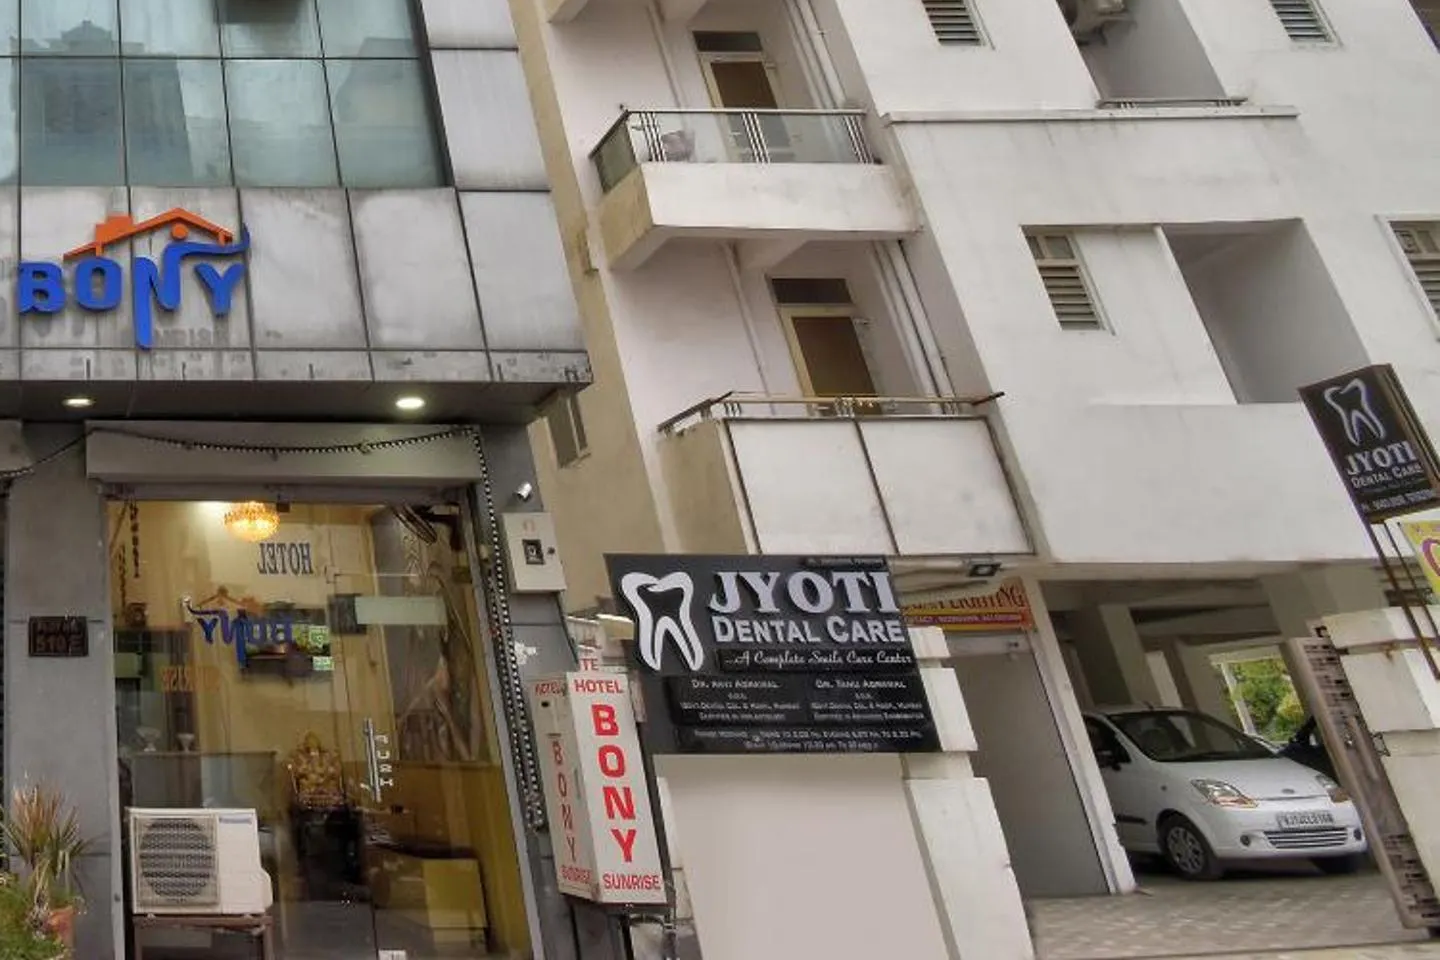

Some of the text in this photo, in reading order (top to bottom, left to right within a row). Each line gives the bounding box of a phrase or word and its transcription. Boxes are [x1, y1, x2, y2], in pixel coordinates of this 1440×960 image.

[18, 223, 251, 351] BONY
[1345, 441, 1417, 476] JYOTI
[709, 570, 901, 614] JYOTI
[711, 615, 906, 644] DENTAL CARE
[754, 650, 806, 668] Complete
[574, 679, 624, 695] HOTEL
[591, 703, 637, 864] BONY
[550, 741, 577, 863] BONY
[602, 874, 662, 890] SUNRISE
